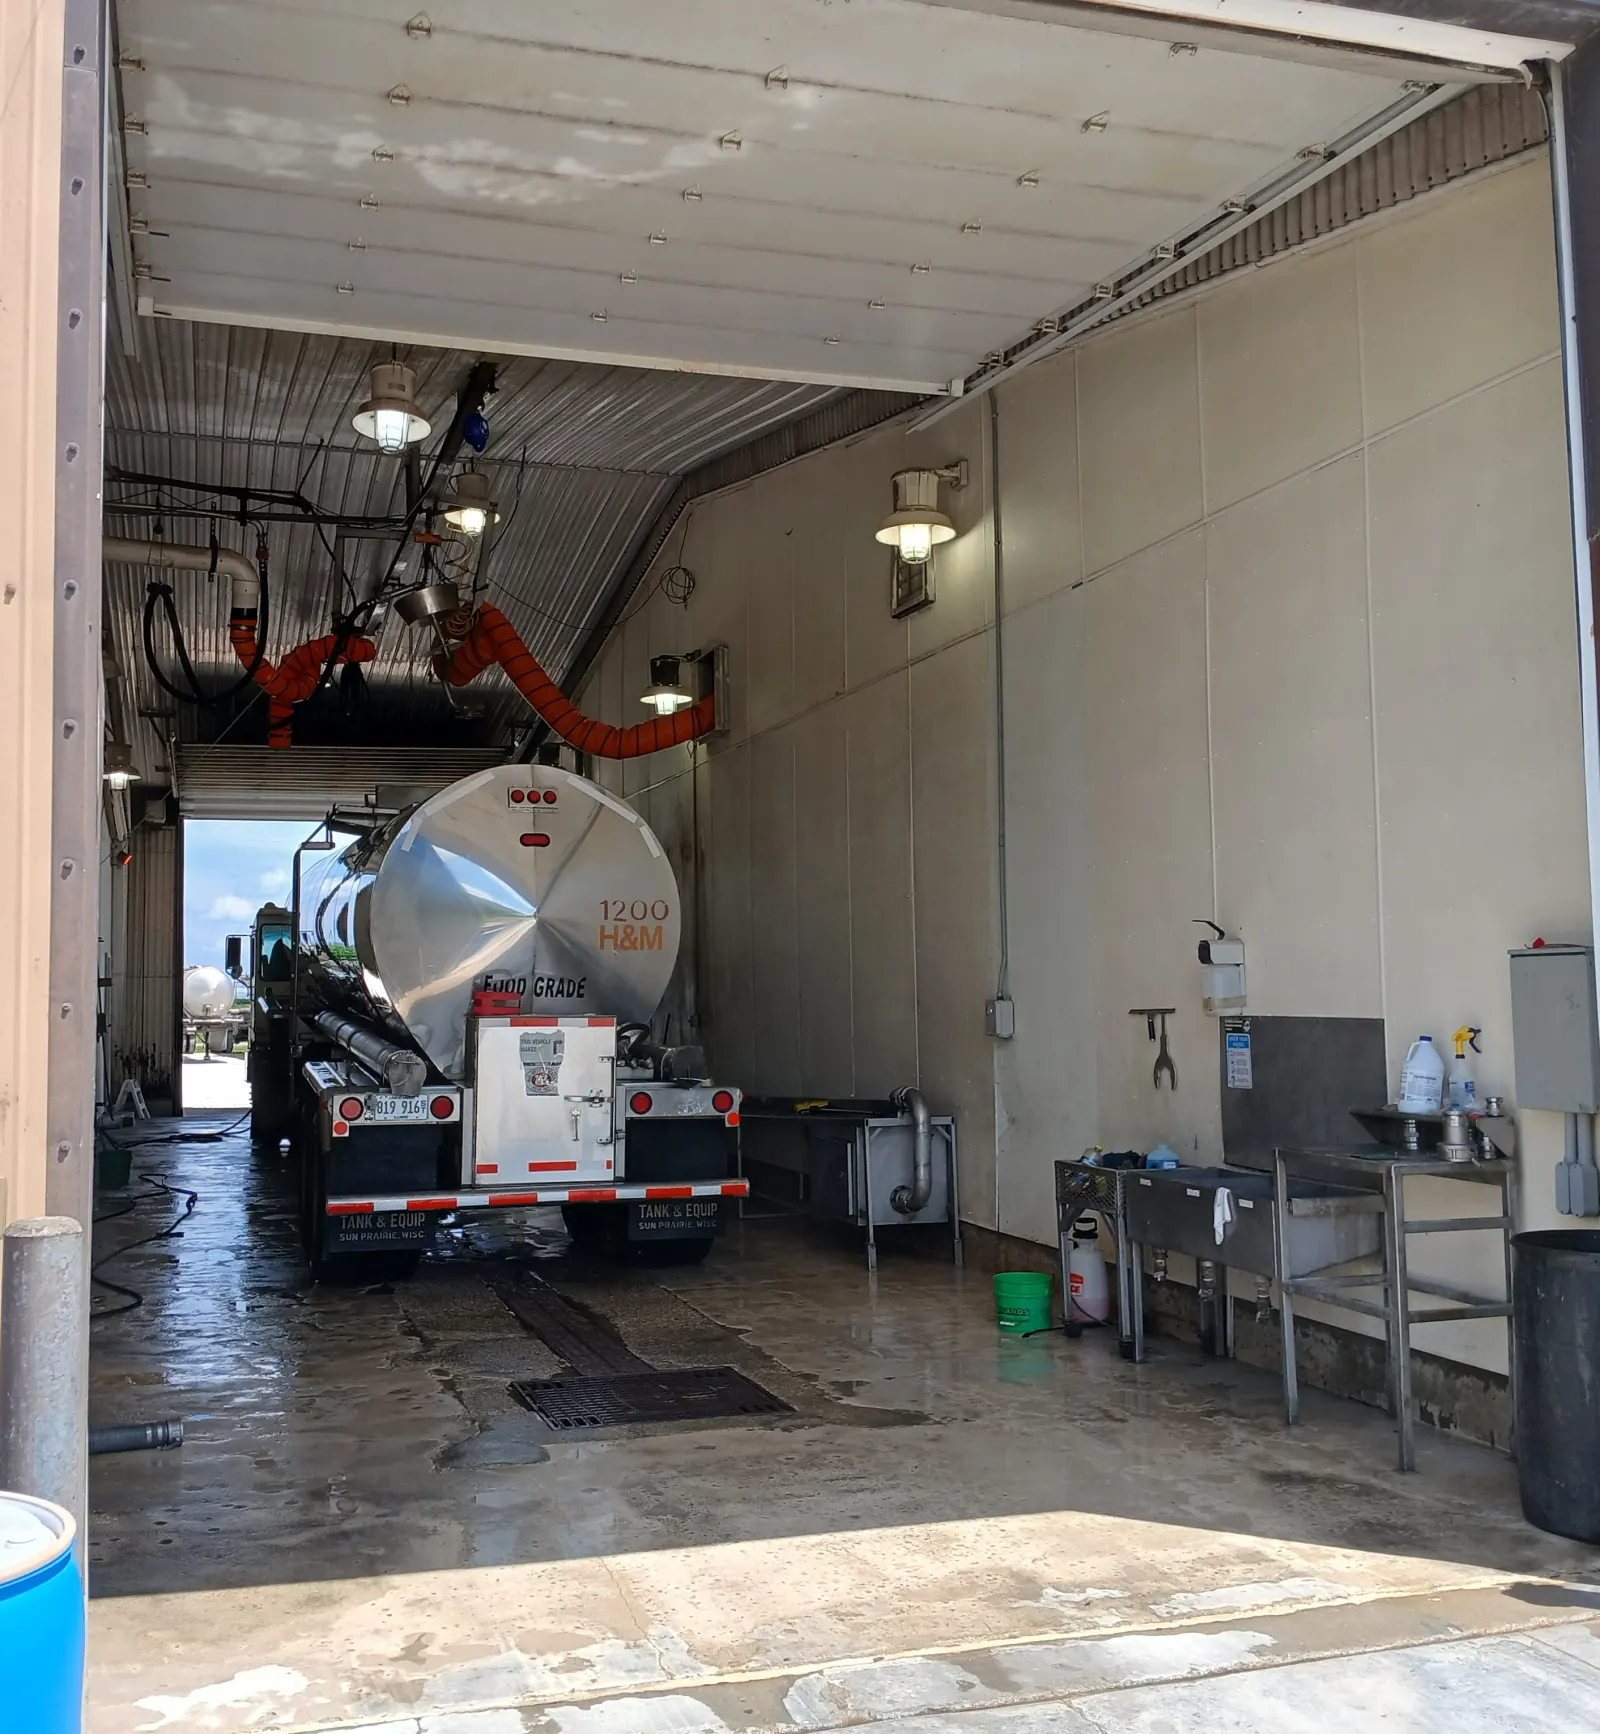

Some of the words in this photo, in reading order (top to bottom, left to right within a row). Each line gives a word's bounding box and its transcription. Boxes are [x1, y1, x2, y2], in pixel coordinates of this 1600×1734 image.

[600, 900, 669, 922] 1200
[599, 925, 664, 950] H&M
[483, 974, 527, 997] FOOD
[534, 976, 587, 999] GRADE
[377, 1100, 396, 1115] 819
[401, 1100, 420, 1114] 916
[639, 1204, 669, 1219] TANK
[673, 1205, 682, 1217] &
[340, 1215, 373, 1229] TANK
[376, 1215, 386, 1229] &
[638, 1222, 657, 1230] SUN
[340, 1233, 359, 1241] SUN
